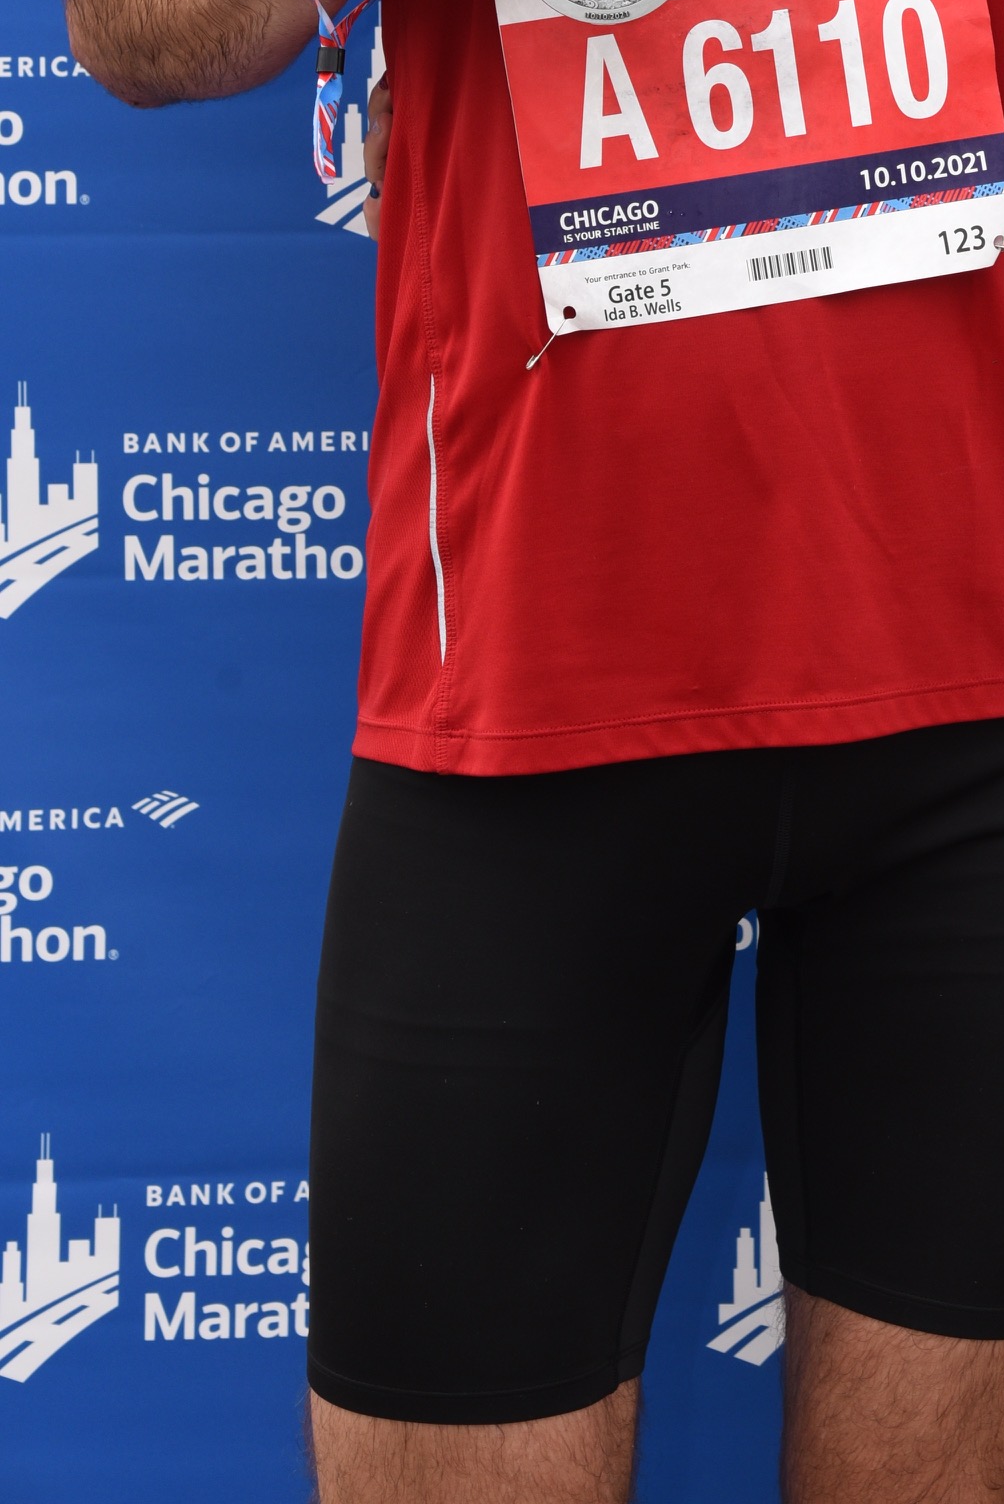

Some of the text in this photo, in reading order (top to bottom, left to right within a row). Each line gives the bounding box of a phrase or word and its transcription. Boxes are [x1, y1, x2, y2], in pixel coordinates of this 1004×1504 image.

[580, 34, 659, 169] A
[861, 151, 988, 189] 10.10.2021
[559, 200, 660, 231] CHICAGO
[564, 221, 659, 242] IS YOUR START LINE
[939, 226, 985, 254] 123
[584, 276, 602, 284] Your
[604, 272, 636, 281] entrance
[649, 266, 670, 274] Grant
[672, 261, 691, 271] Park:
[609, 279, 670, 303] Gate 5
[604, 299, 681, 321] Ida B. Wells
[124, 431, 368, 453] BANK OF AMERI
[122, 473, 346, 533] Chicago
[124, 532, 363, 581] Maratho
[147, 1182, 285, 1206] BANK OF
[144, 1226, 310, 1286] Chica
[144, 1292, 309, 1341] Marat
